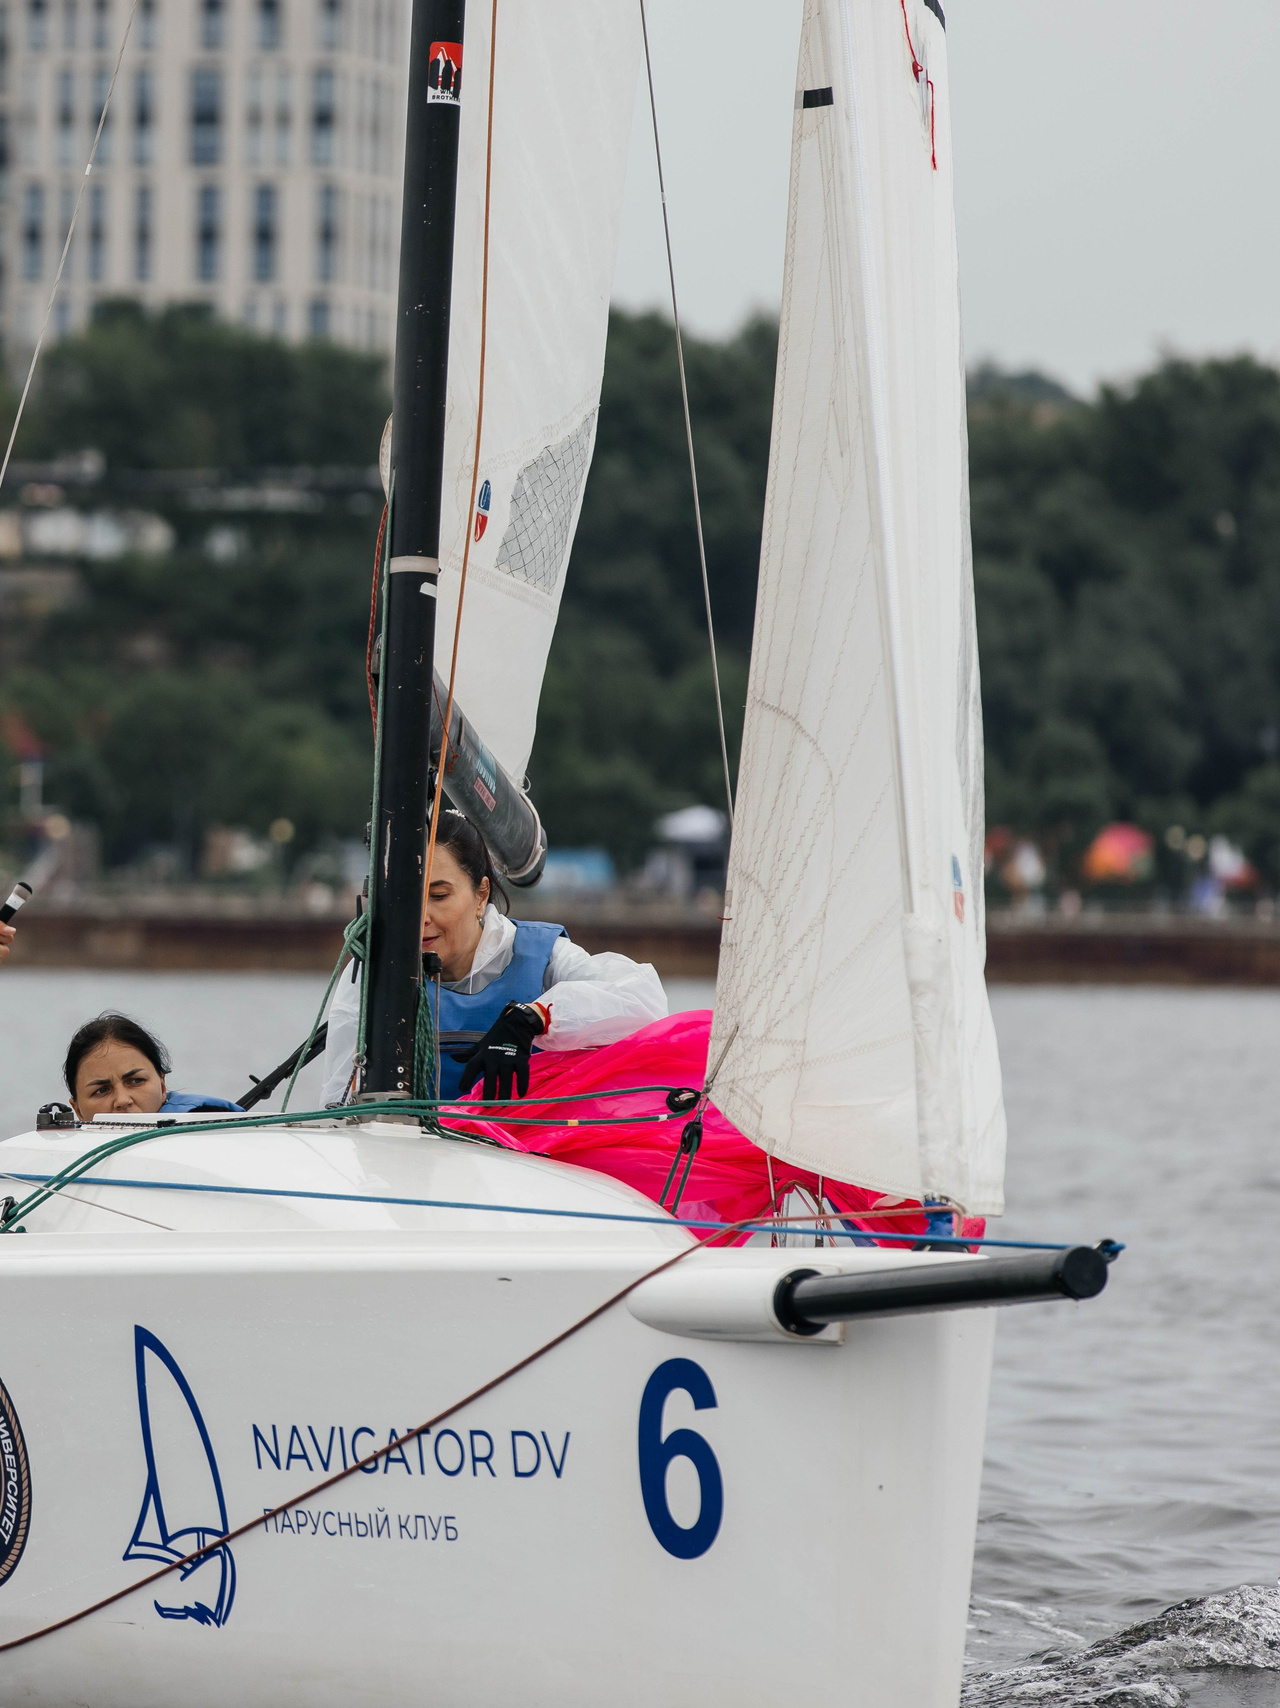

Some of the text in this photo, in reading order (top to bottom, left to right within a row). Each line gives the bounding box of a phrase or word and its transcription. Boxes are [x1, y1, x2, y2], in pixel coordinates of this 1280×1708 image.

[252, 1423, 571, 1479] NAVIGATOR DV
[637, 1357, 724, 1560] 6
[263, 1507, 459, 1541] ПАРУСНЫЙ КЛУБ
